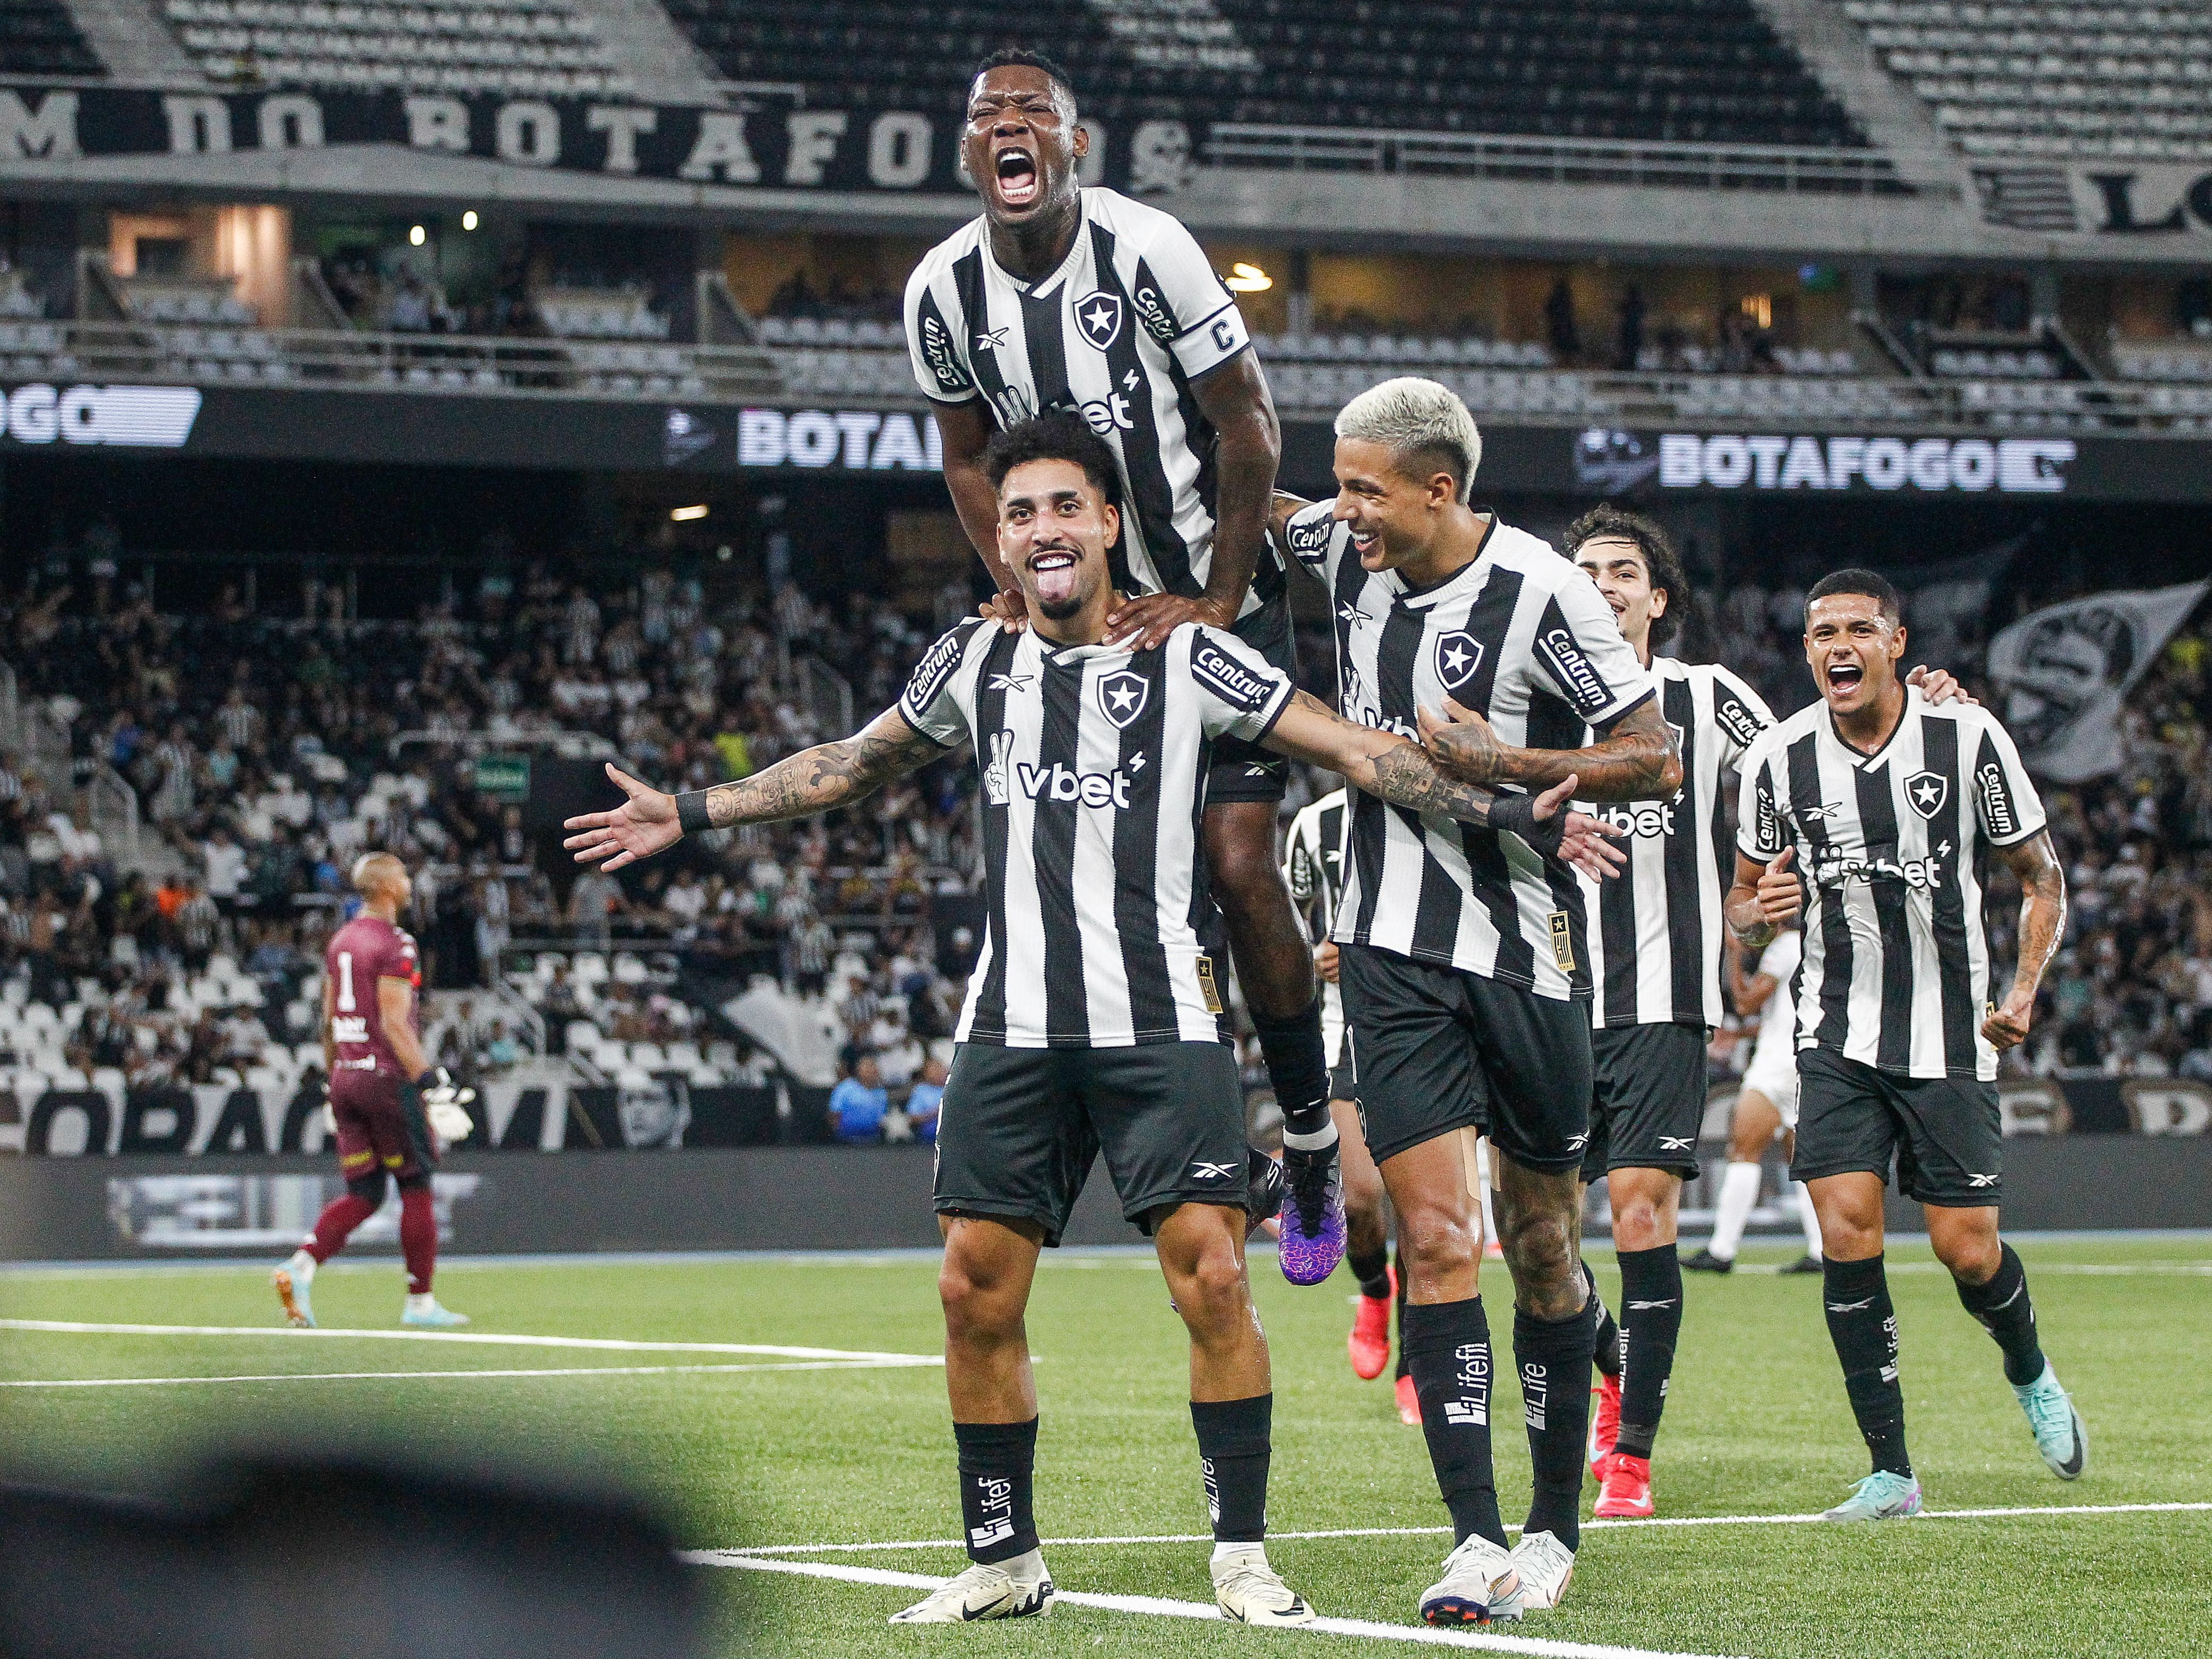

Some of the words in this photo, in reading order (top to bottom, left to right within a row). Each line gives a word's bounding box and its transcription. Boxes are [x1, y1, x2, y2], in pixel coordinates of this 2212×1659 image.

[405, 95, 1106, 190] BOTAFO
[1211, 319, 1235, 352] C
[0, 382, 105, 446] GO
[1062, 392, 1134, 435] et
[1659, 433, 1995, 492] BOTAFOGO
[910, 636, 959, 703] Centrum
[1547, 628, 1607, 706] Centrum
[1017, 760, 1131, 809] vbet
[1983, 763, 2012, 833] Centrum
[337, 951, 356, 1012] 1
